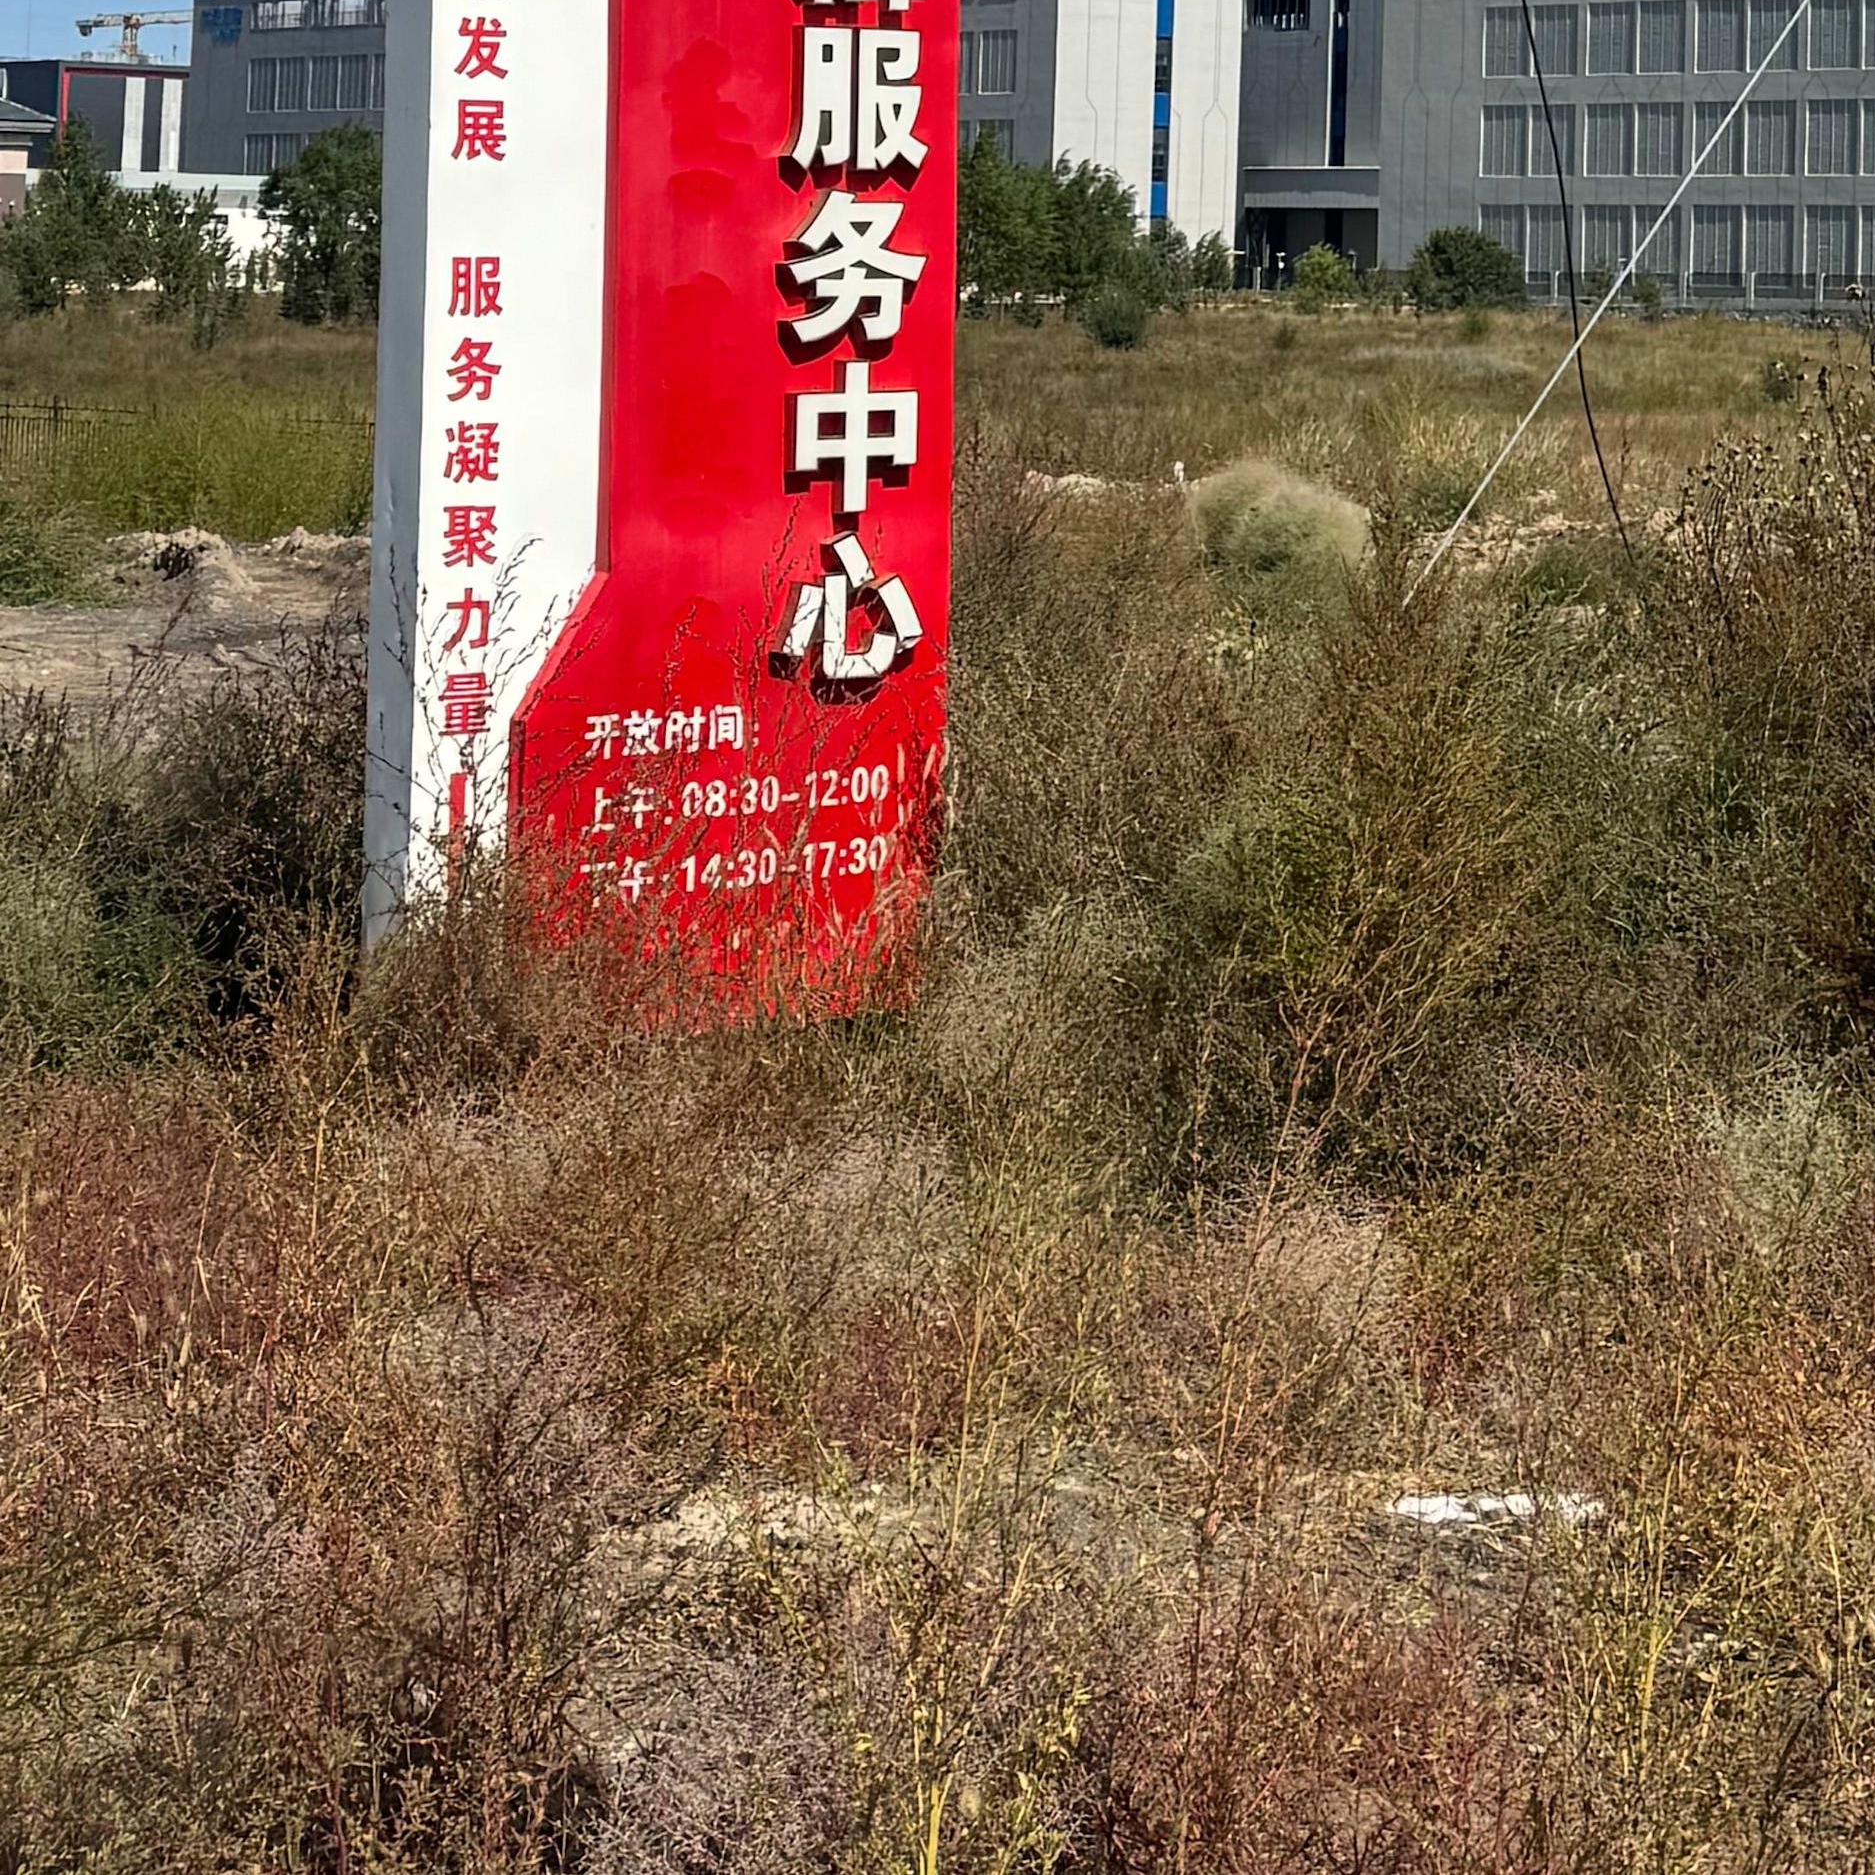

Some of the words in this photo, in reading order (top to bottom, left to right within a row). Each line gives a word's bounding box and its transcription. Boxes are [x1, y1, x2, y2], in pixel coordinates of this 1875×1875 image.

[437, 255, 502, 737] 服务凝聚力量
